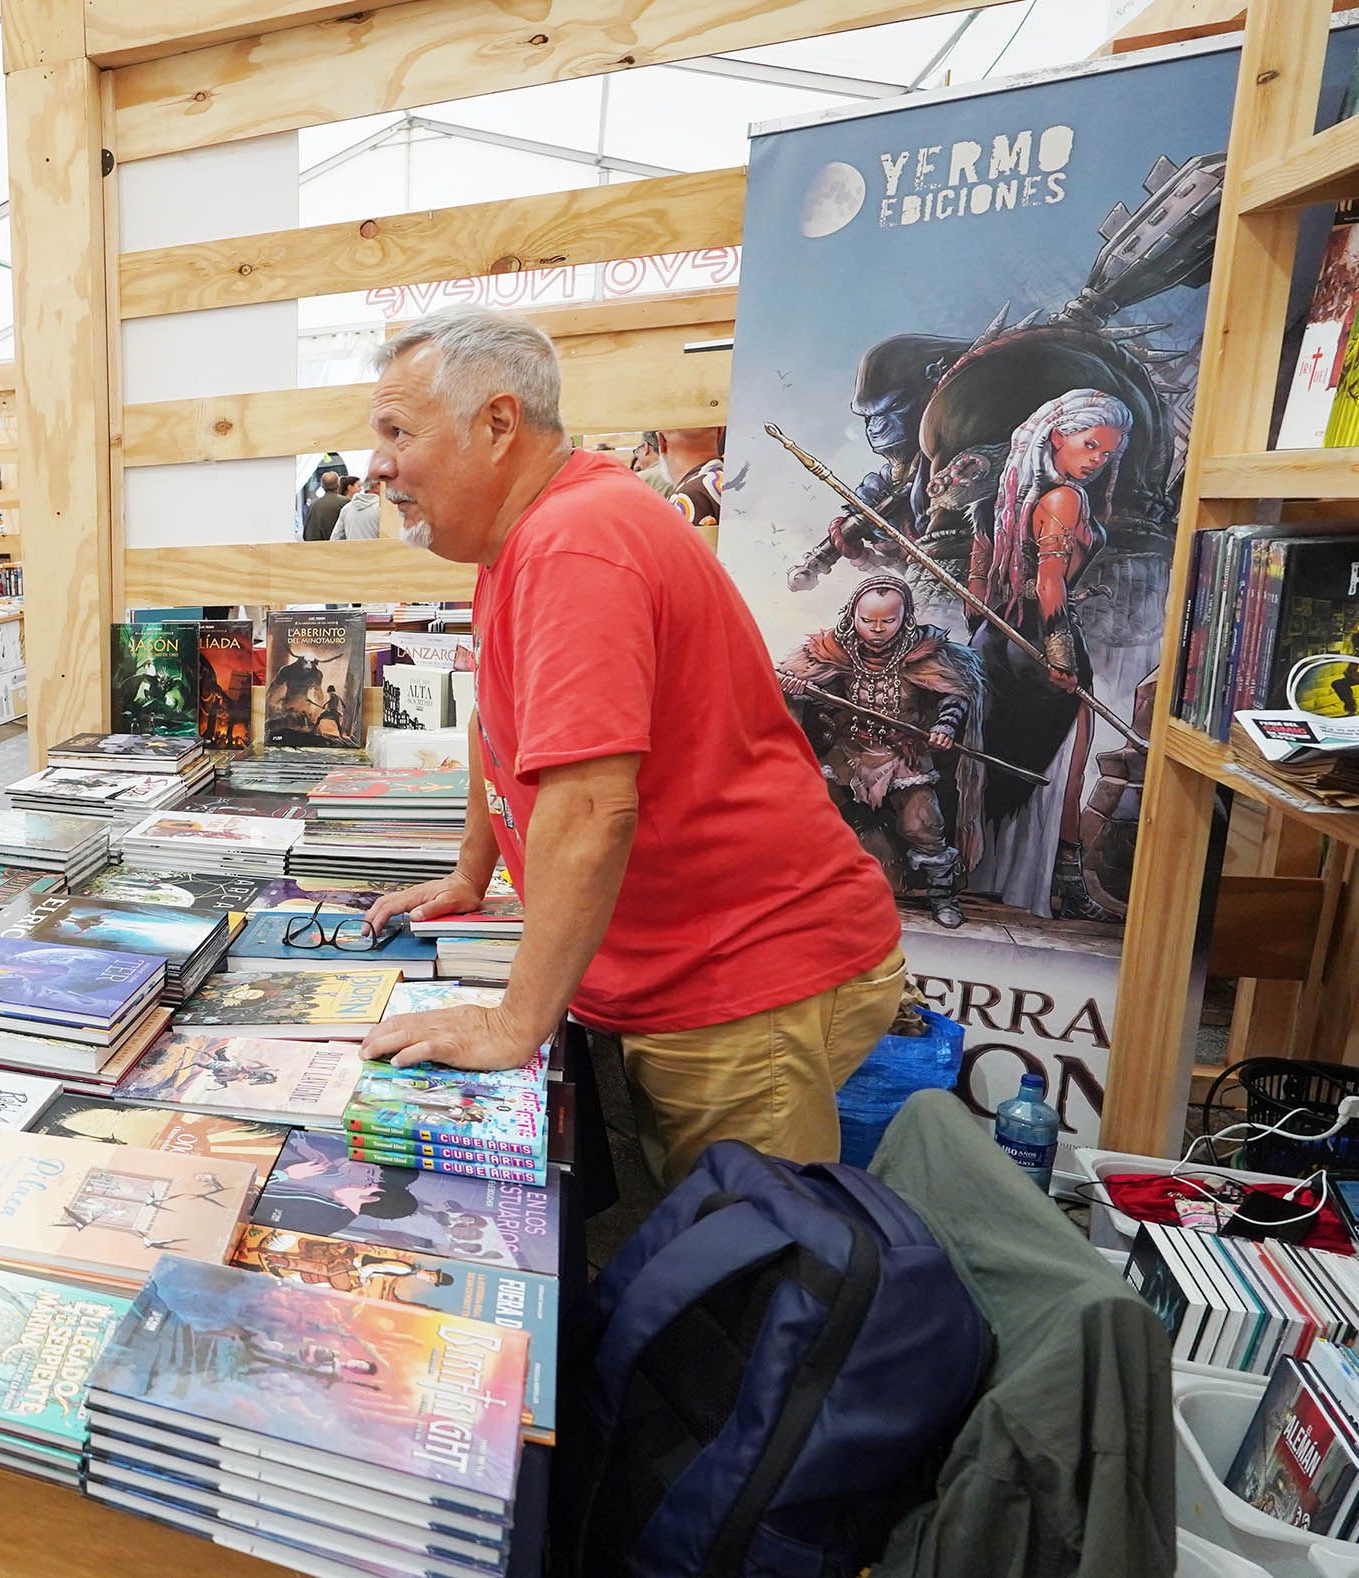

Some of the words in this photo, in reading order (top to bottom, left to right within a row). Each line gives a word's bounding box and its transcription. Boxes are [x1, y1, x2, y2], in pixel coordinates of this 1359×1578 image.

[880, 125, 1074, 196] YERMO
[879, 173, 1067, 227] EDICIONES
[130, 636, 179, 652] JASÓN
[288, 627, 346, 637] LABERINTO
[408, 685, 432, 700] ALTA
[213, 879, 255, 908] ARCA
[0, 897, 70, 939] ELRIC
[439, 1133, 483, 1148] CUBE
[487, 1140, 533, 1155] ARTS
[442, 1148, 486, 1163] CUBE
[490, 1154, 535, 1169] ARTS
[442, 1162, 486, 1177] CUBE
[491, 1167, 535, 1183] ARTS
[525, 1191, 548, 1209] EN
[524, 1209, 548, 1237] LOS
[495, 1278, 526, 1315] FUERA
[8, 1289, 62, 1356] MARINA
[18, 1326, 73, 1415] SERPIENTE
[413, 1324, 506, 1474] BIRTHRIGHT
[1283, 1414, 1322, 1478] ALEMÁN
